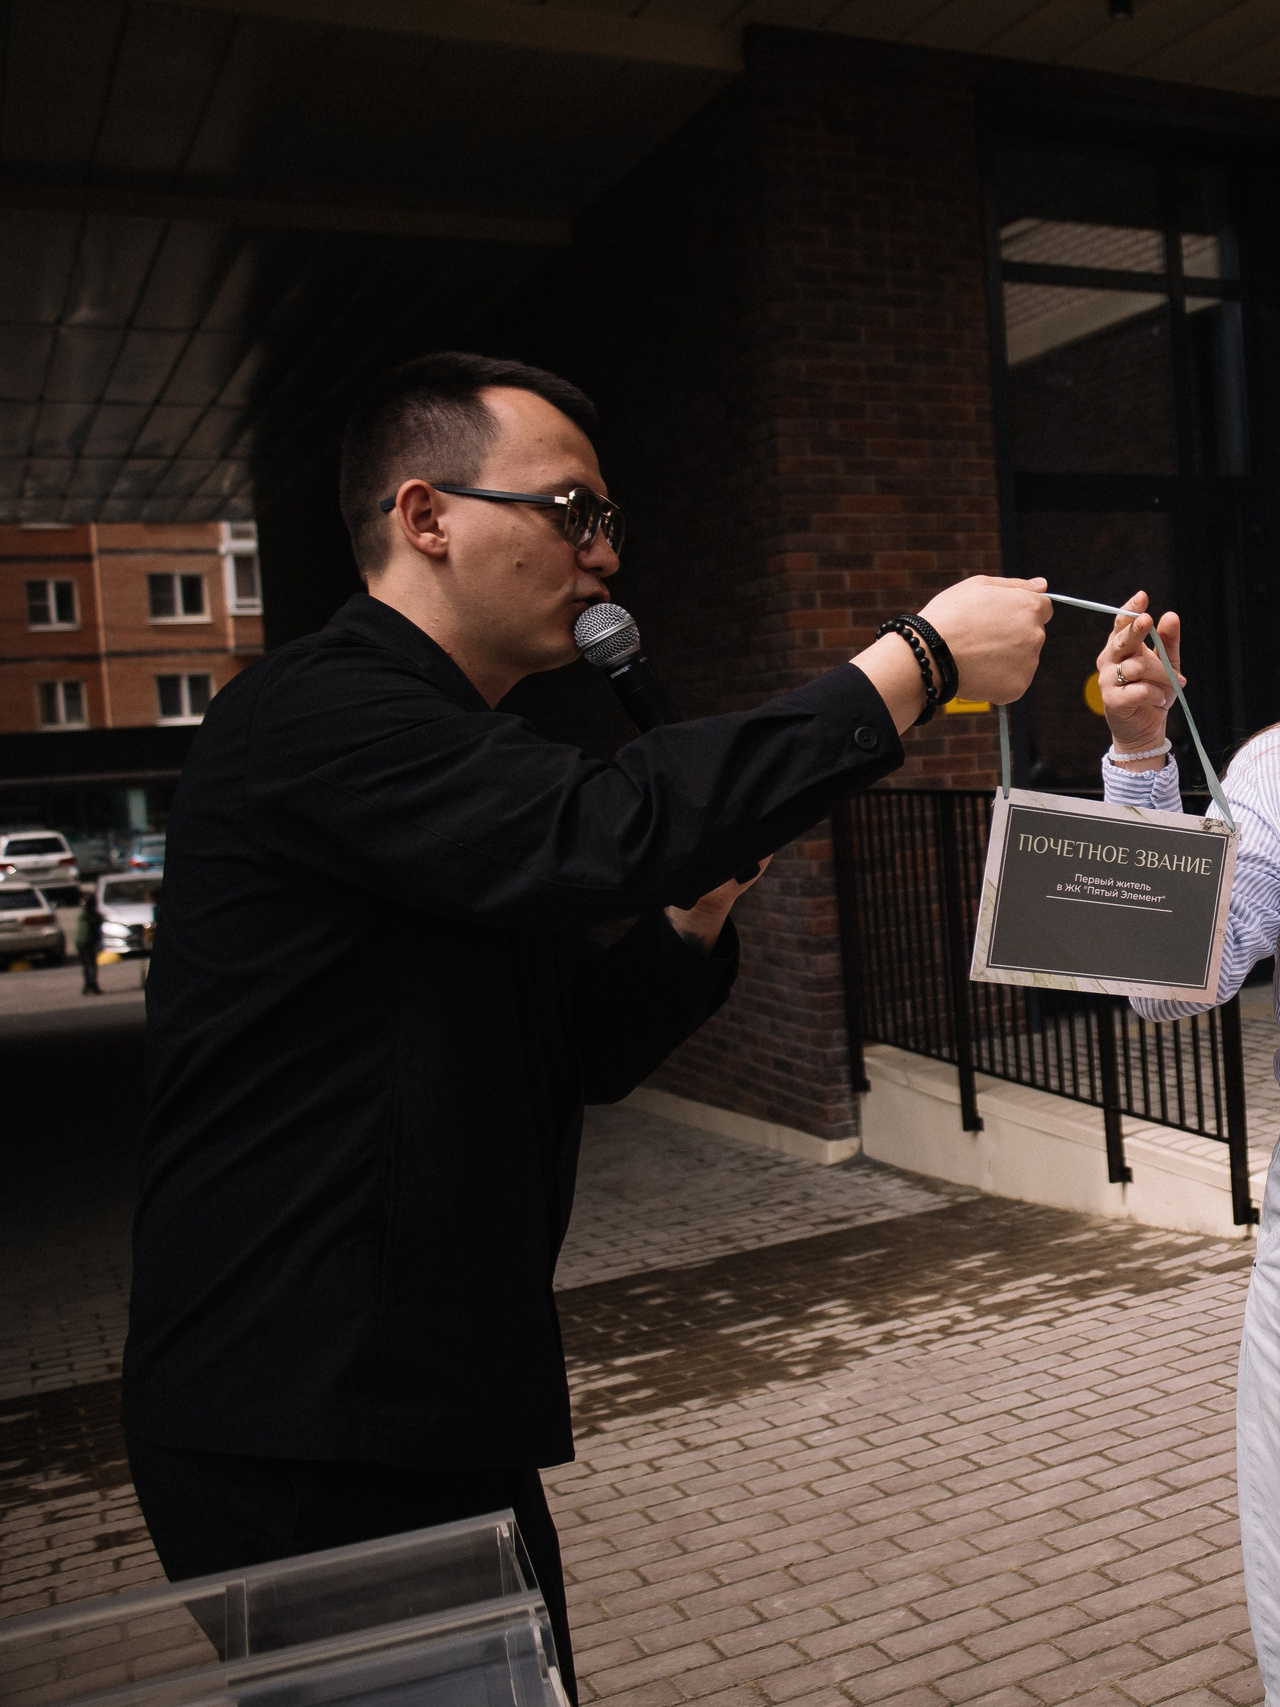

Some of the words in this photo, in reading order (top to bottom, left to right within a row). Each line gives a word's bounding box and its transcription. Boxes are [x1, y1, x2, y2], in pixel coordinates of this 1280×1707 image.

[1018, 833, 1130, 865] ПОЧЕТНОЕ
[1133, 849, 1213, 876] ЗВАНИЕ
[1074, 873, 1115, 887] Первый
[1115, 880, 1152, 891] житель
[1056, 883, 1063, 891] в
[1064, 883, 1082, 893] ЖК
[1083, 885, 1119, 898] "Пятый
[1120, 890, 1166, 903] Элемент"
